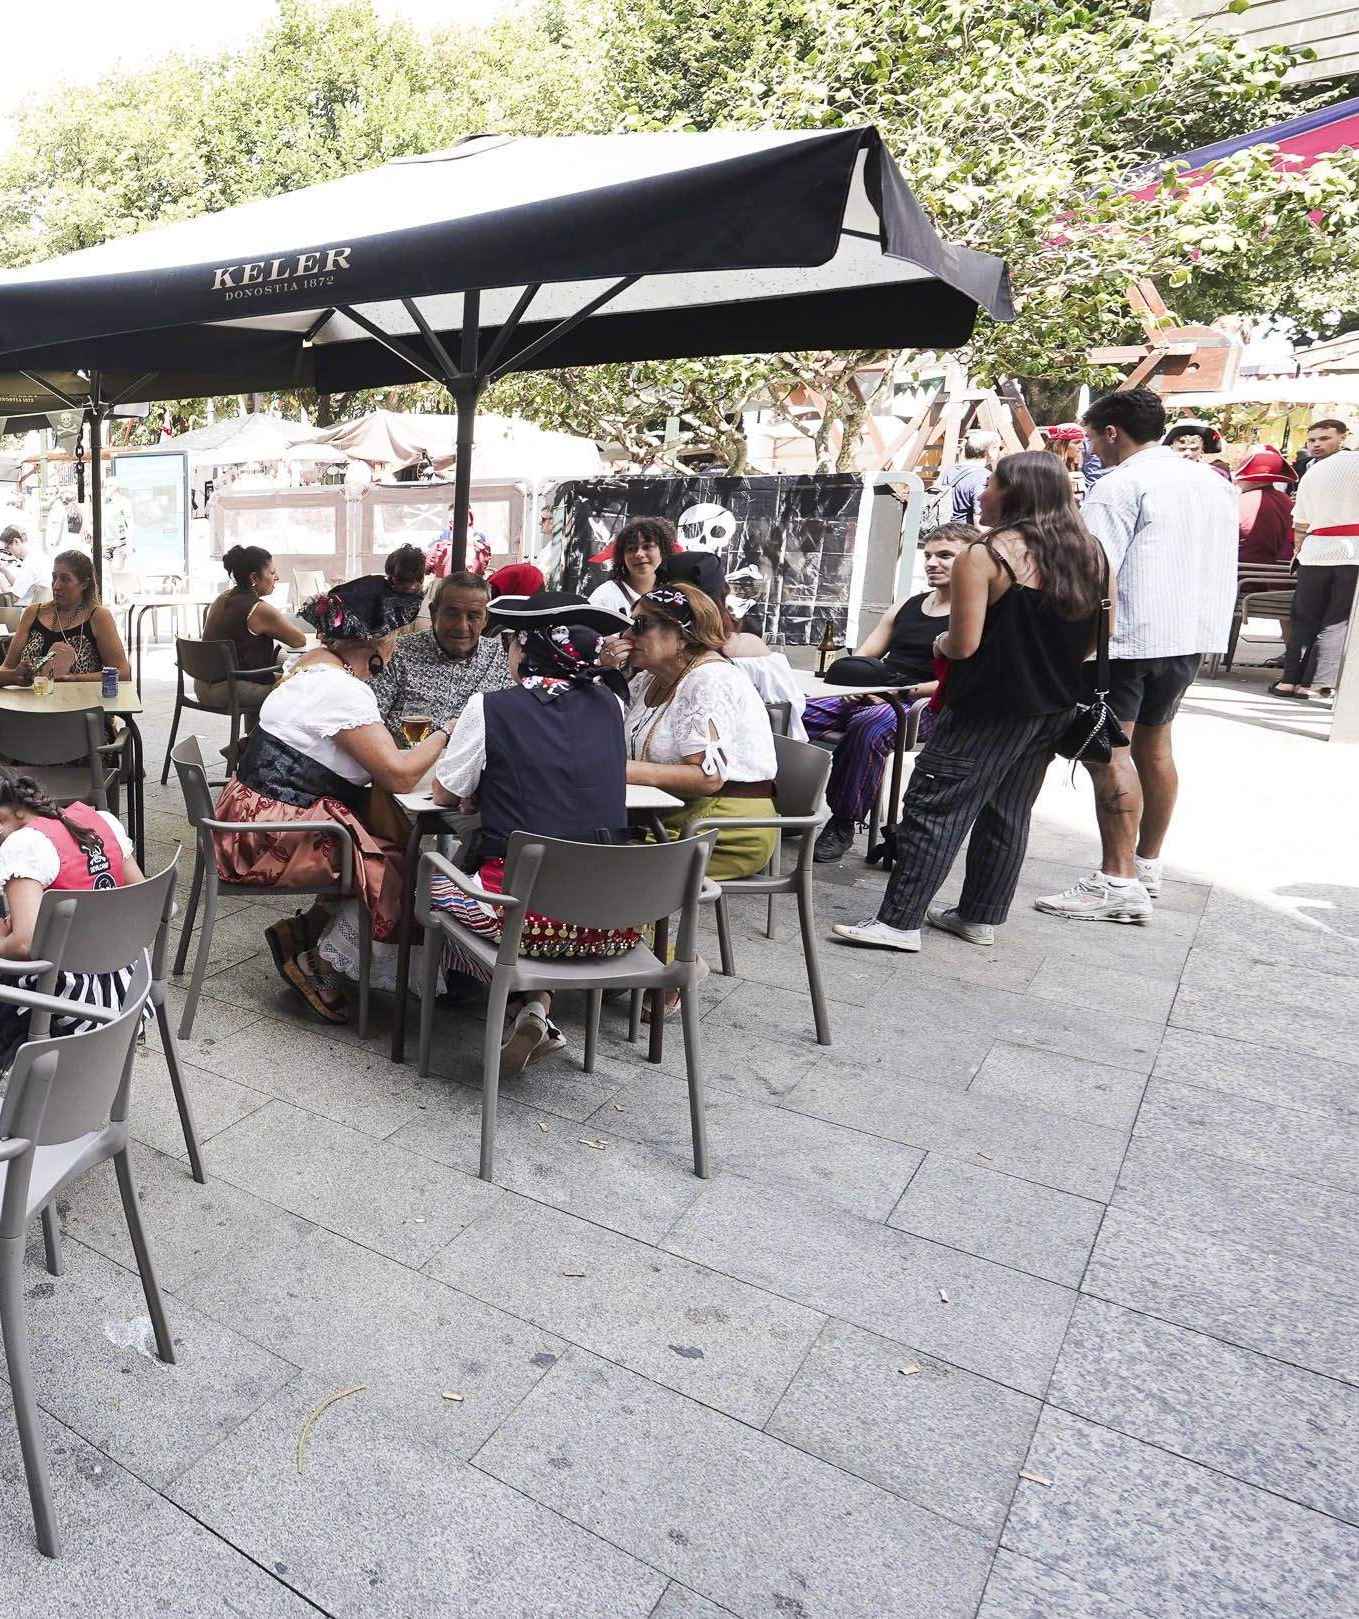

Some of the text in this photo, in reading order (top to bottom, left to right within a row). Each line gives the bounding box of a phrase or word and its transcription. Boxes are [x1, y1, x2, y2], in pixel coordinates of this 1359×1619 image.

[210, 247, 352, 291] KELER
[225, 275, 334, 301] DONOSTIA 1872
